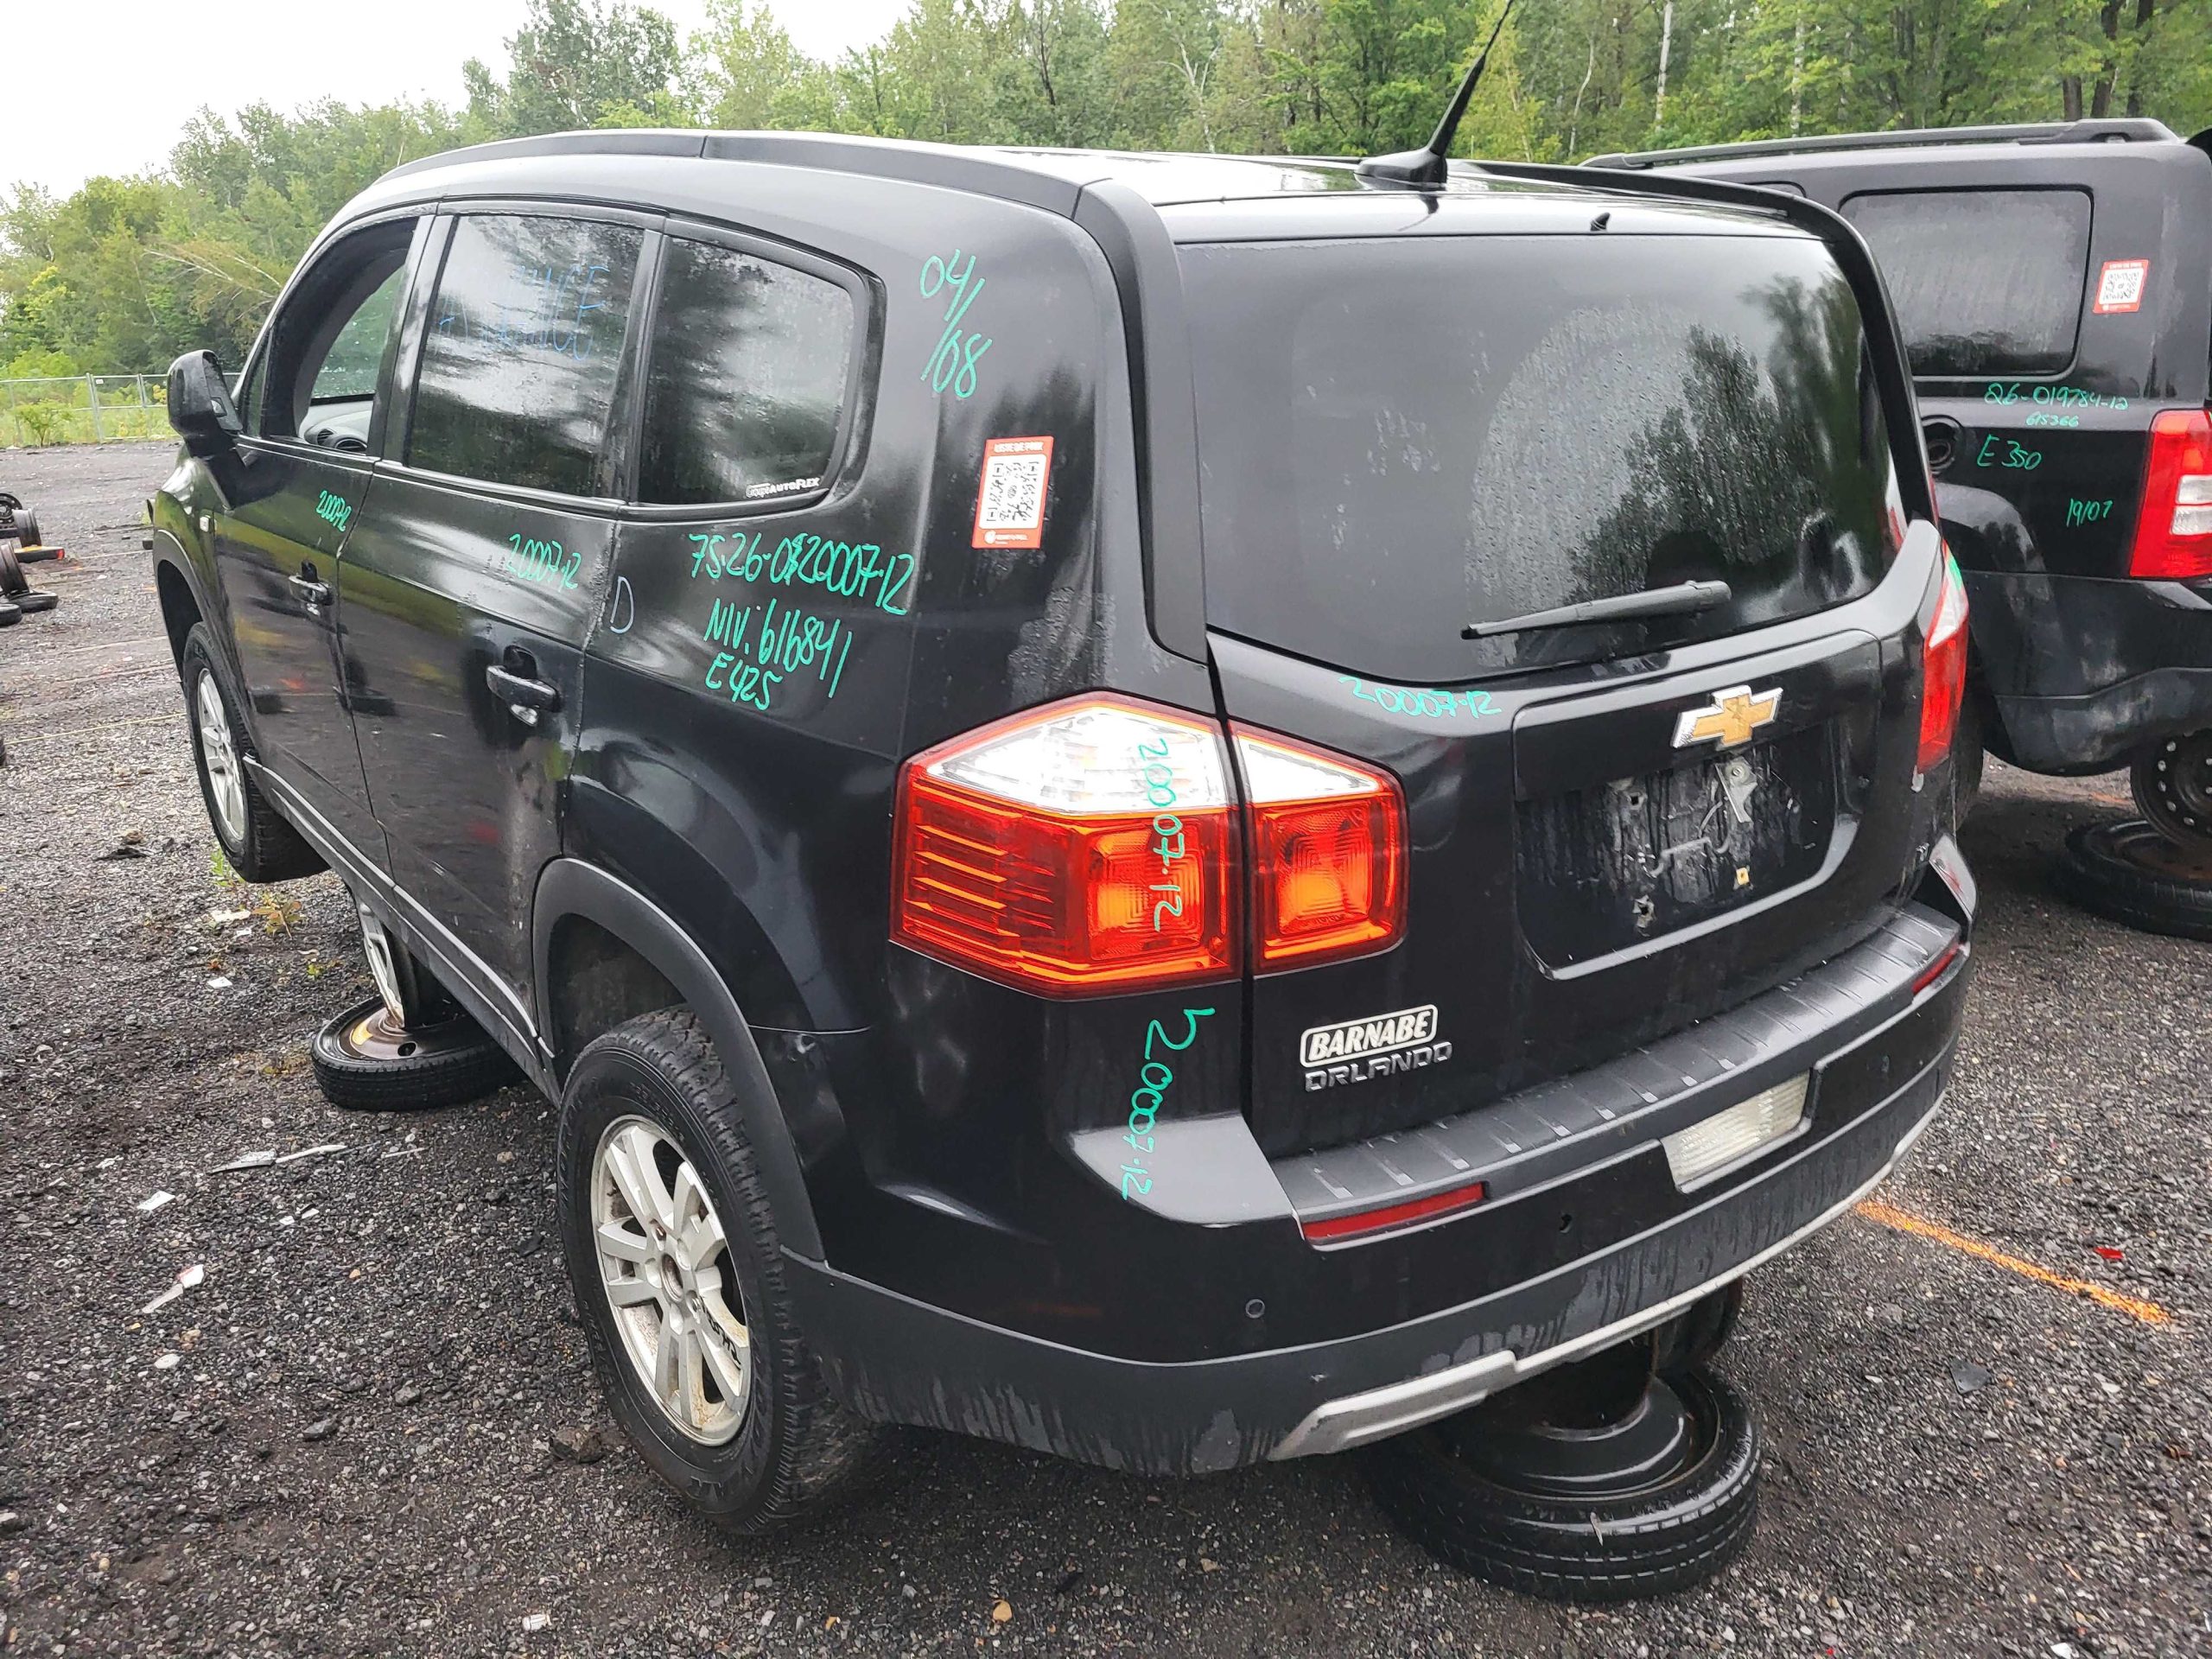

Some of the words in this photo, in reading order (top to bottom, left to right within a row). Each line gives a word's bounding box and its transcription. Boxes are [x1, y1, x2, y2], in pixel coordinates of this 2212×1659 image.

[1977, 434, 2000, 467] E
[2001, 440, 2042, 470] 350
[610, 575, 634, 634] D
[1307, 1011, 1432, 1062] BARNABE
[1305, 1041, 1453, 1093] ORLANDO
